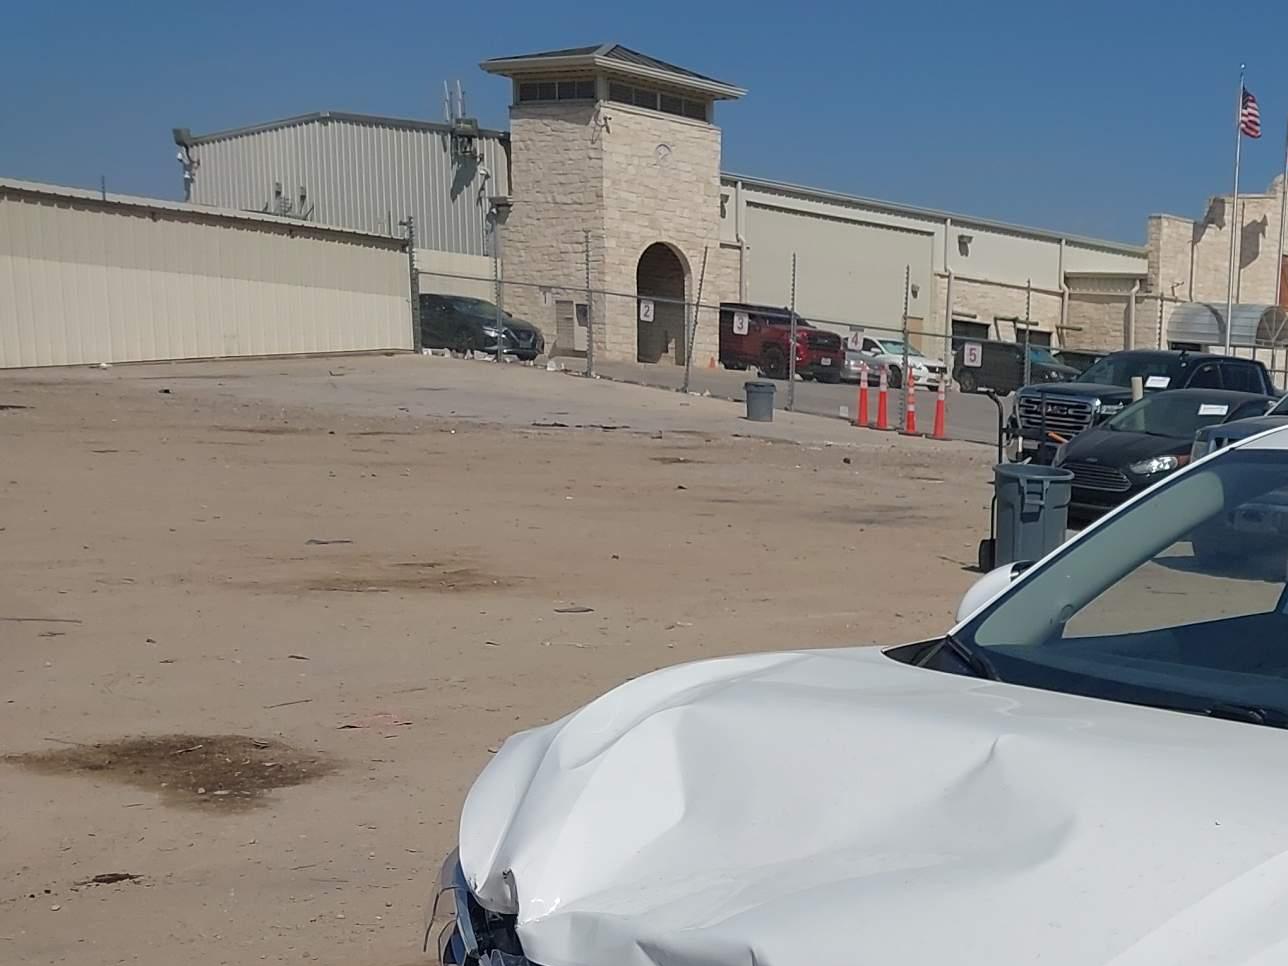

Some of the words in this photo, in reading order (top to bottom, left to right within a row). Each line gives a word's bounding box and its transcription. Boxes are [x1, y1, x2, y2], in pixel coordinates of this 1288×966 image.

[642, 304, 650, 318] 2
[737, 314, 744, 330] 3
[851, 332, 861, 347] 4
[969, 347, 977, 361] 5
